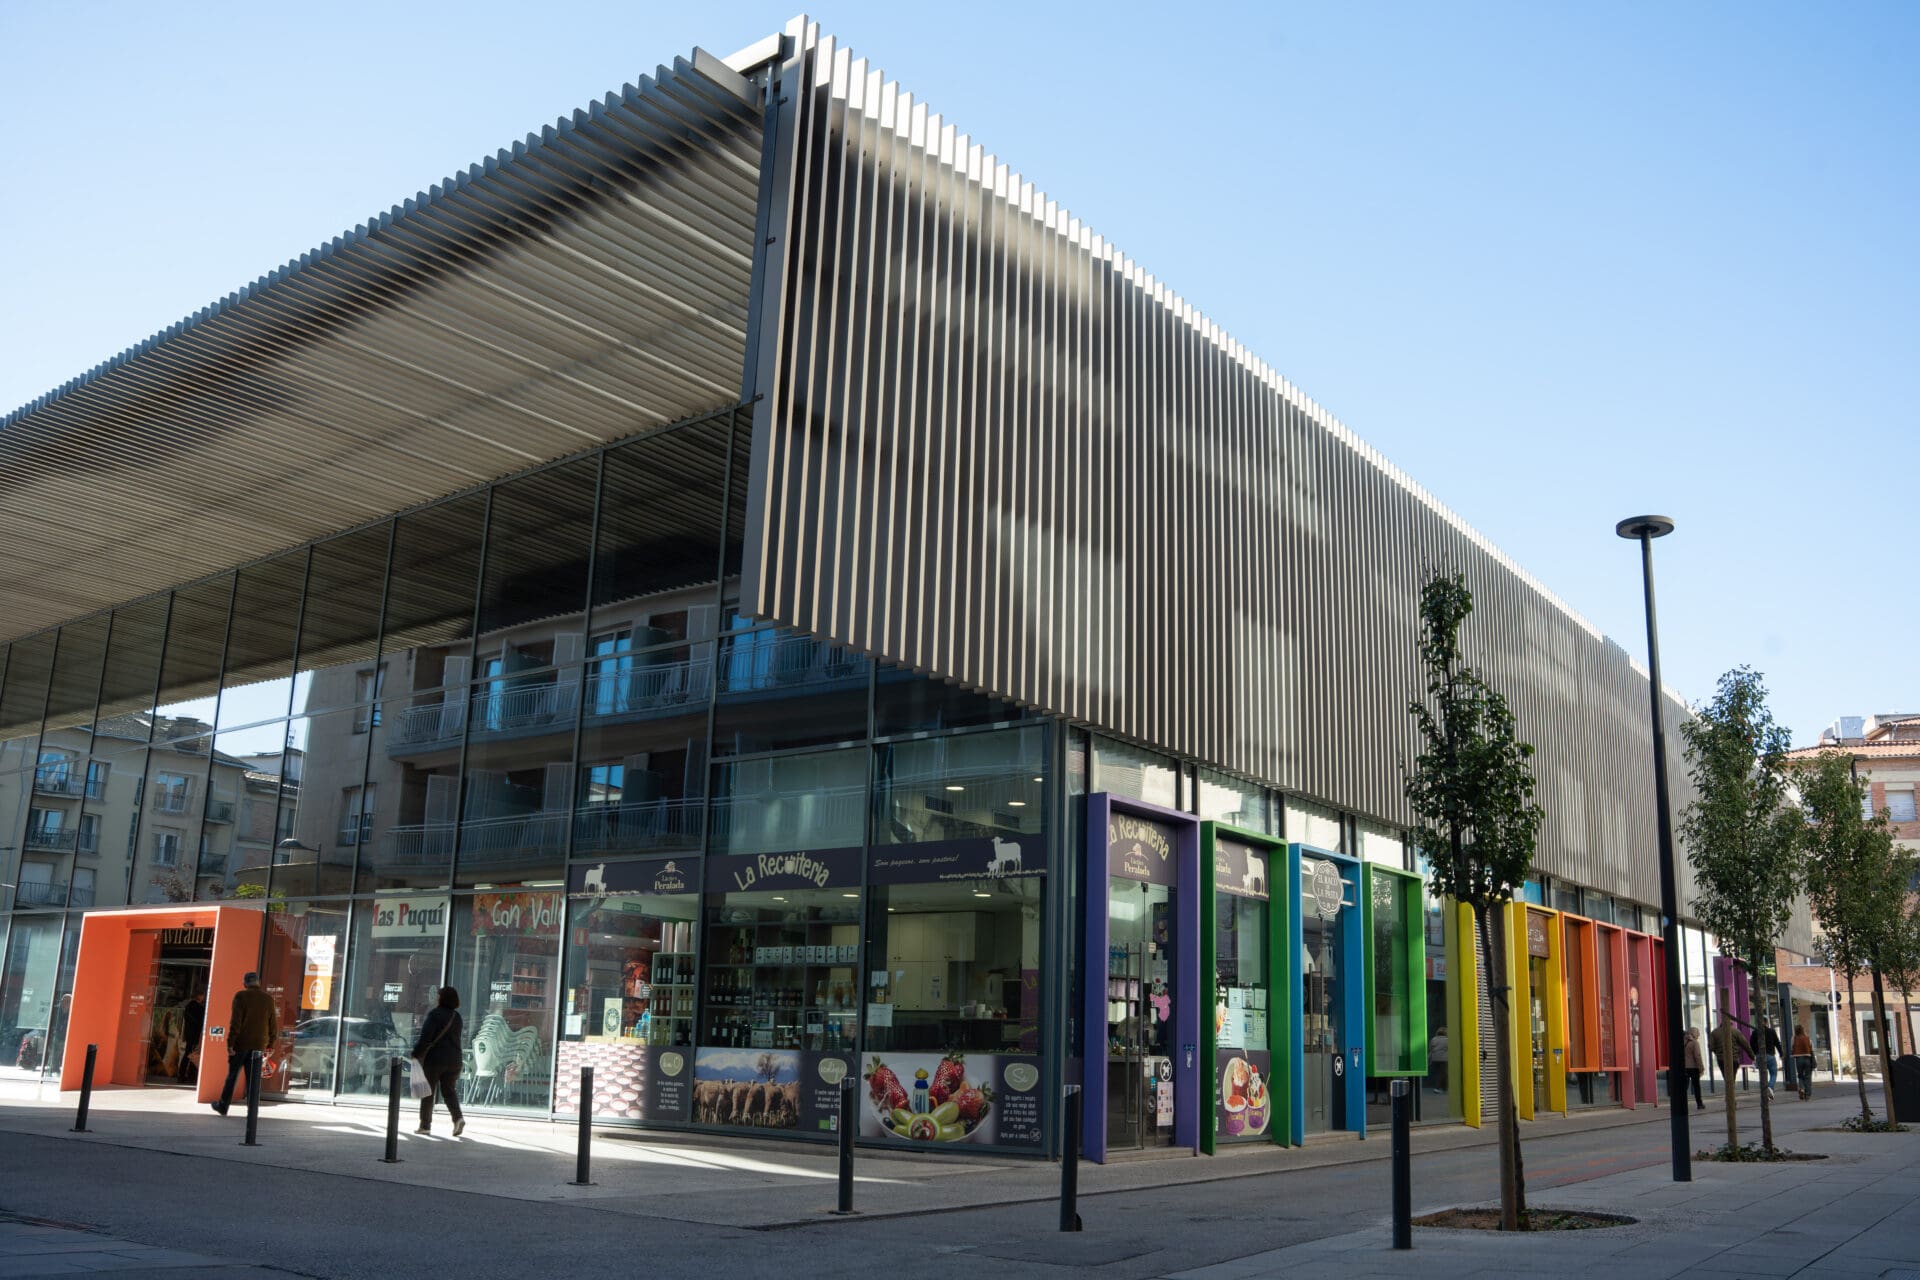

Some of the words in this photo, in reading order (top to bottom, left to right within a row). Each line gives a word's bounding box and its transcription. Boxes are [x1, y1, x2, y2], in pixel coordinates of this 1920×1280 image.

[734, 865, 756, 891] La
[398, 902, 444, 933] Puquí
[492, 899, 522, 929] Can
